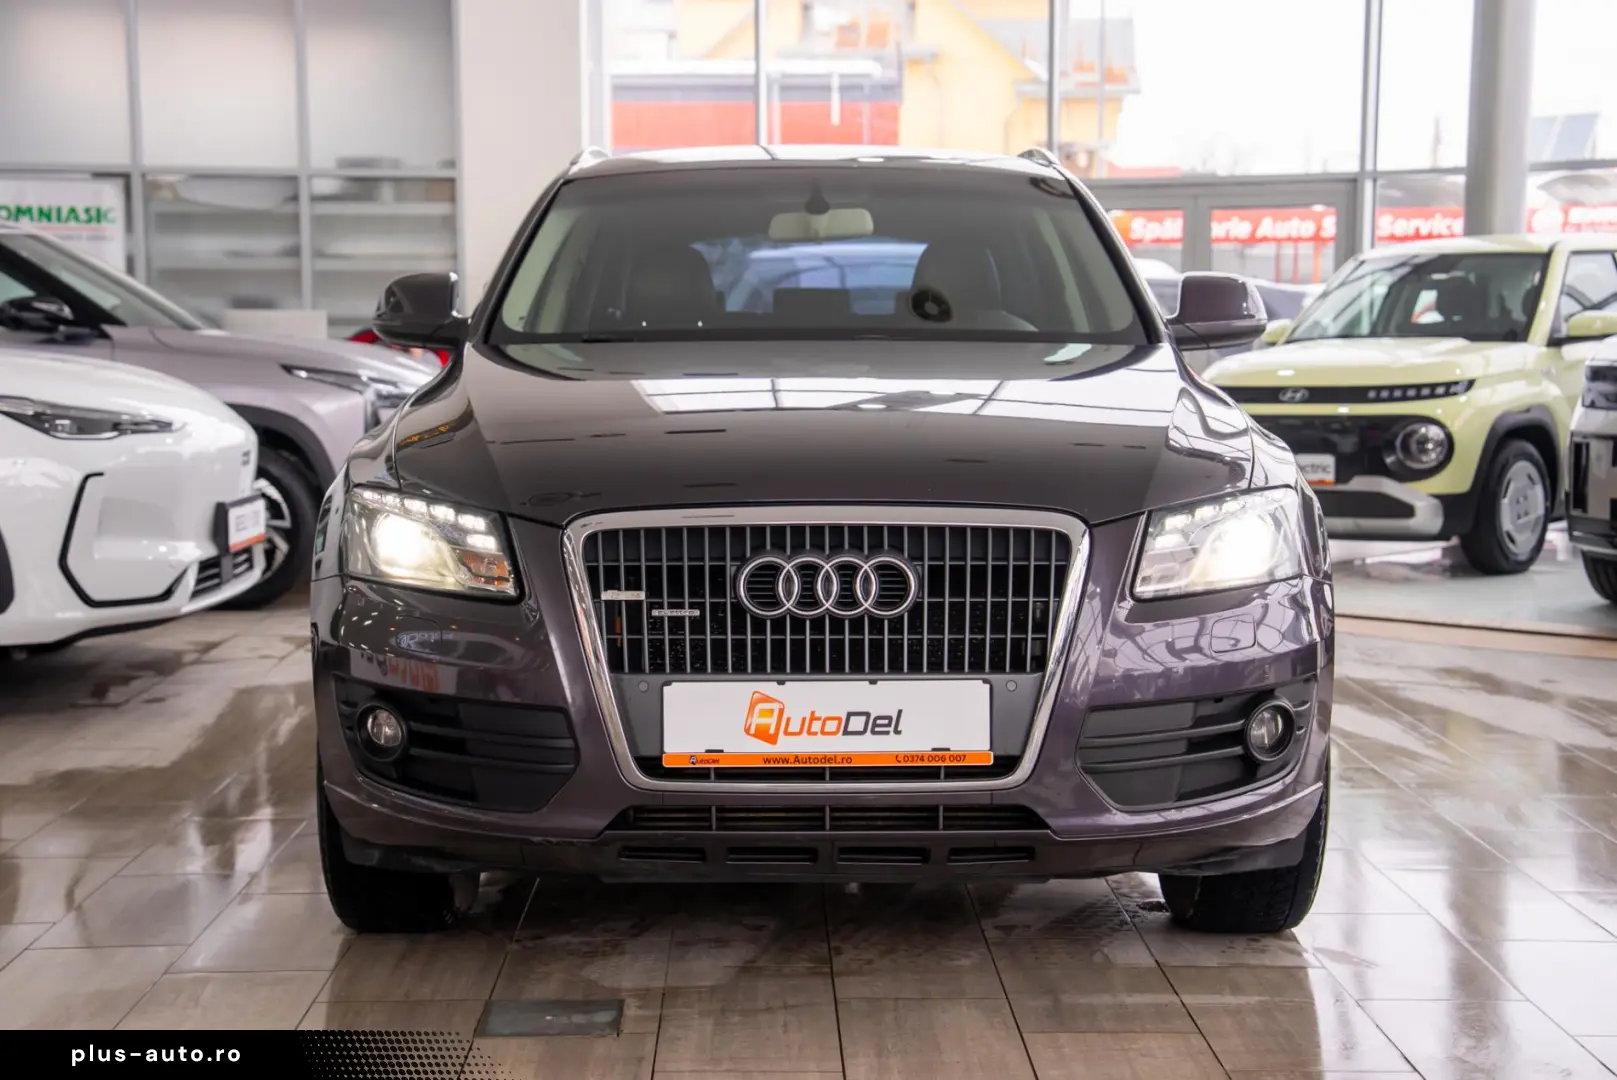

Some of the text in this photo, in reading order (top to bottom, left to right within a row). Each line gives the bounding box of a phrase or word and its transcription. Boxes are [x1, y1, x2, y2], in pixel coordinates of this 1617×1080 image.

[1254, 214, 1316, 240] Auto
[749, 700, 903, 737] AutoDel
[689, 755, 720, 765] AutoDel
[762, 755, 853, 765] www.Autodel.ro
[903, 754, 967, 763] 0374 006 007
